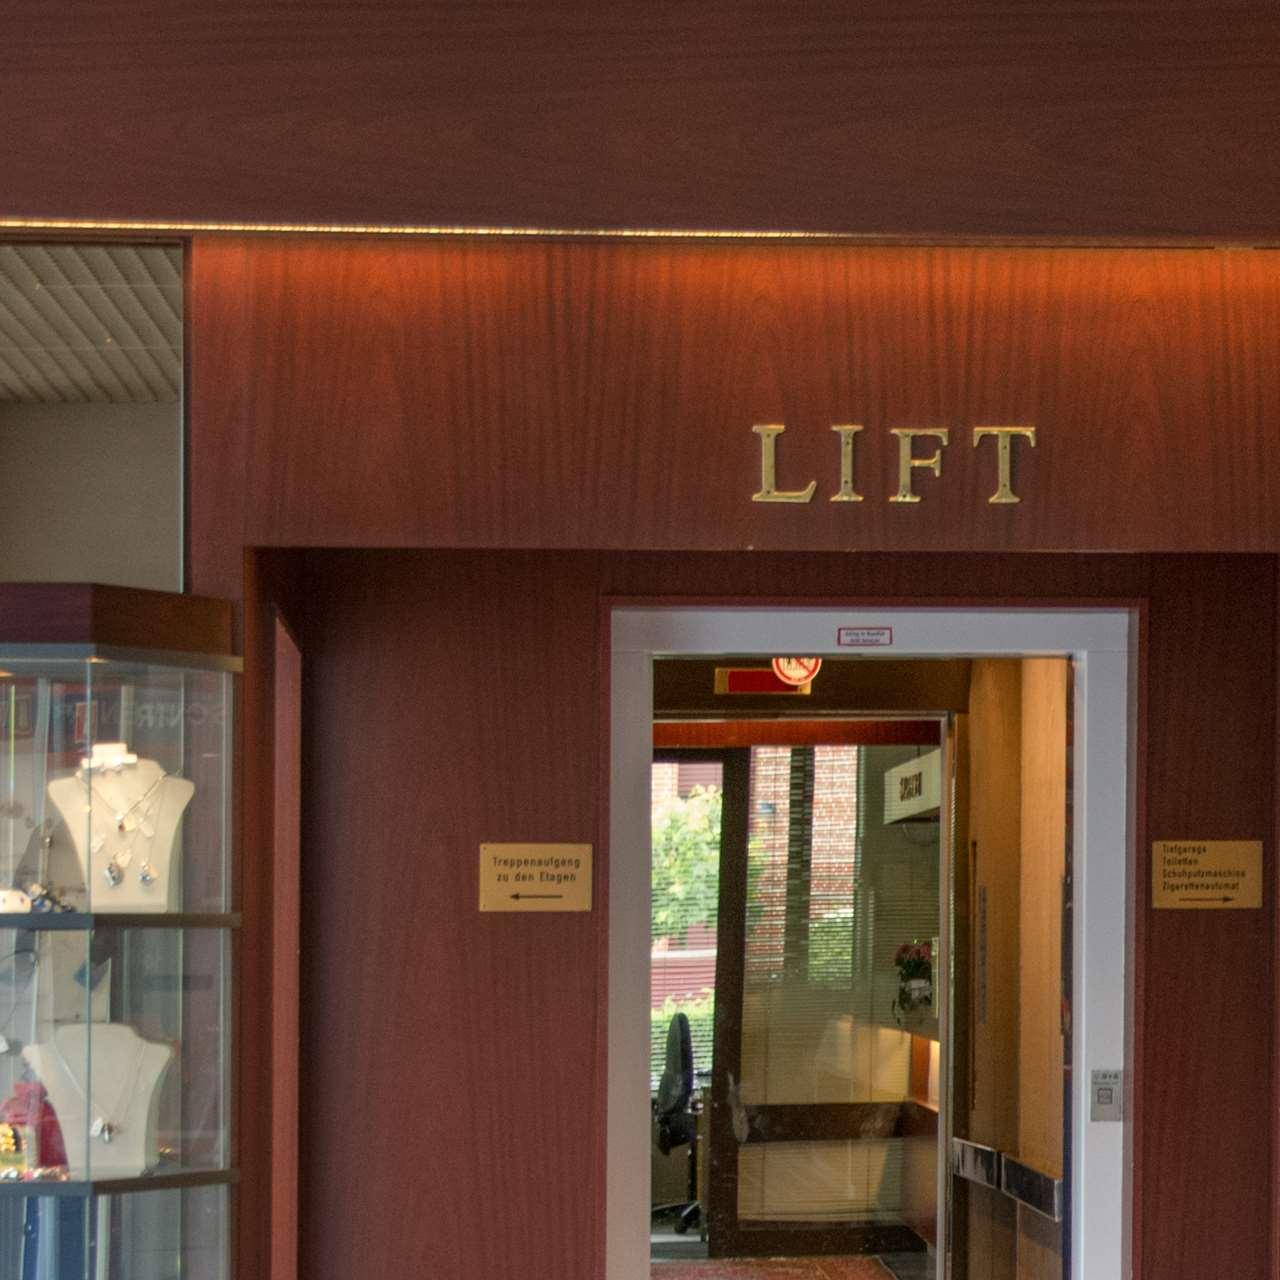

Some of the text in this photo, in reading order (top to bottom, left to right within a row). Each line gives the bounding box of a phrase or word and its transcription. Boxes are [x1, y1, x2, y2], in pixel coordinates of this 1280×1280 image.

[752, 424, 1036, 503] LIFT
[493, 856, 581, 869] Treppenaufgang
[496, 871, 577, 884] zu den Etagen
